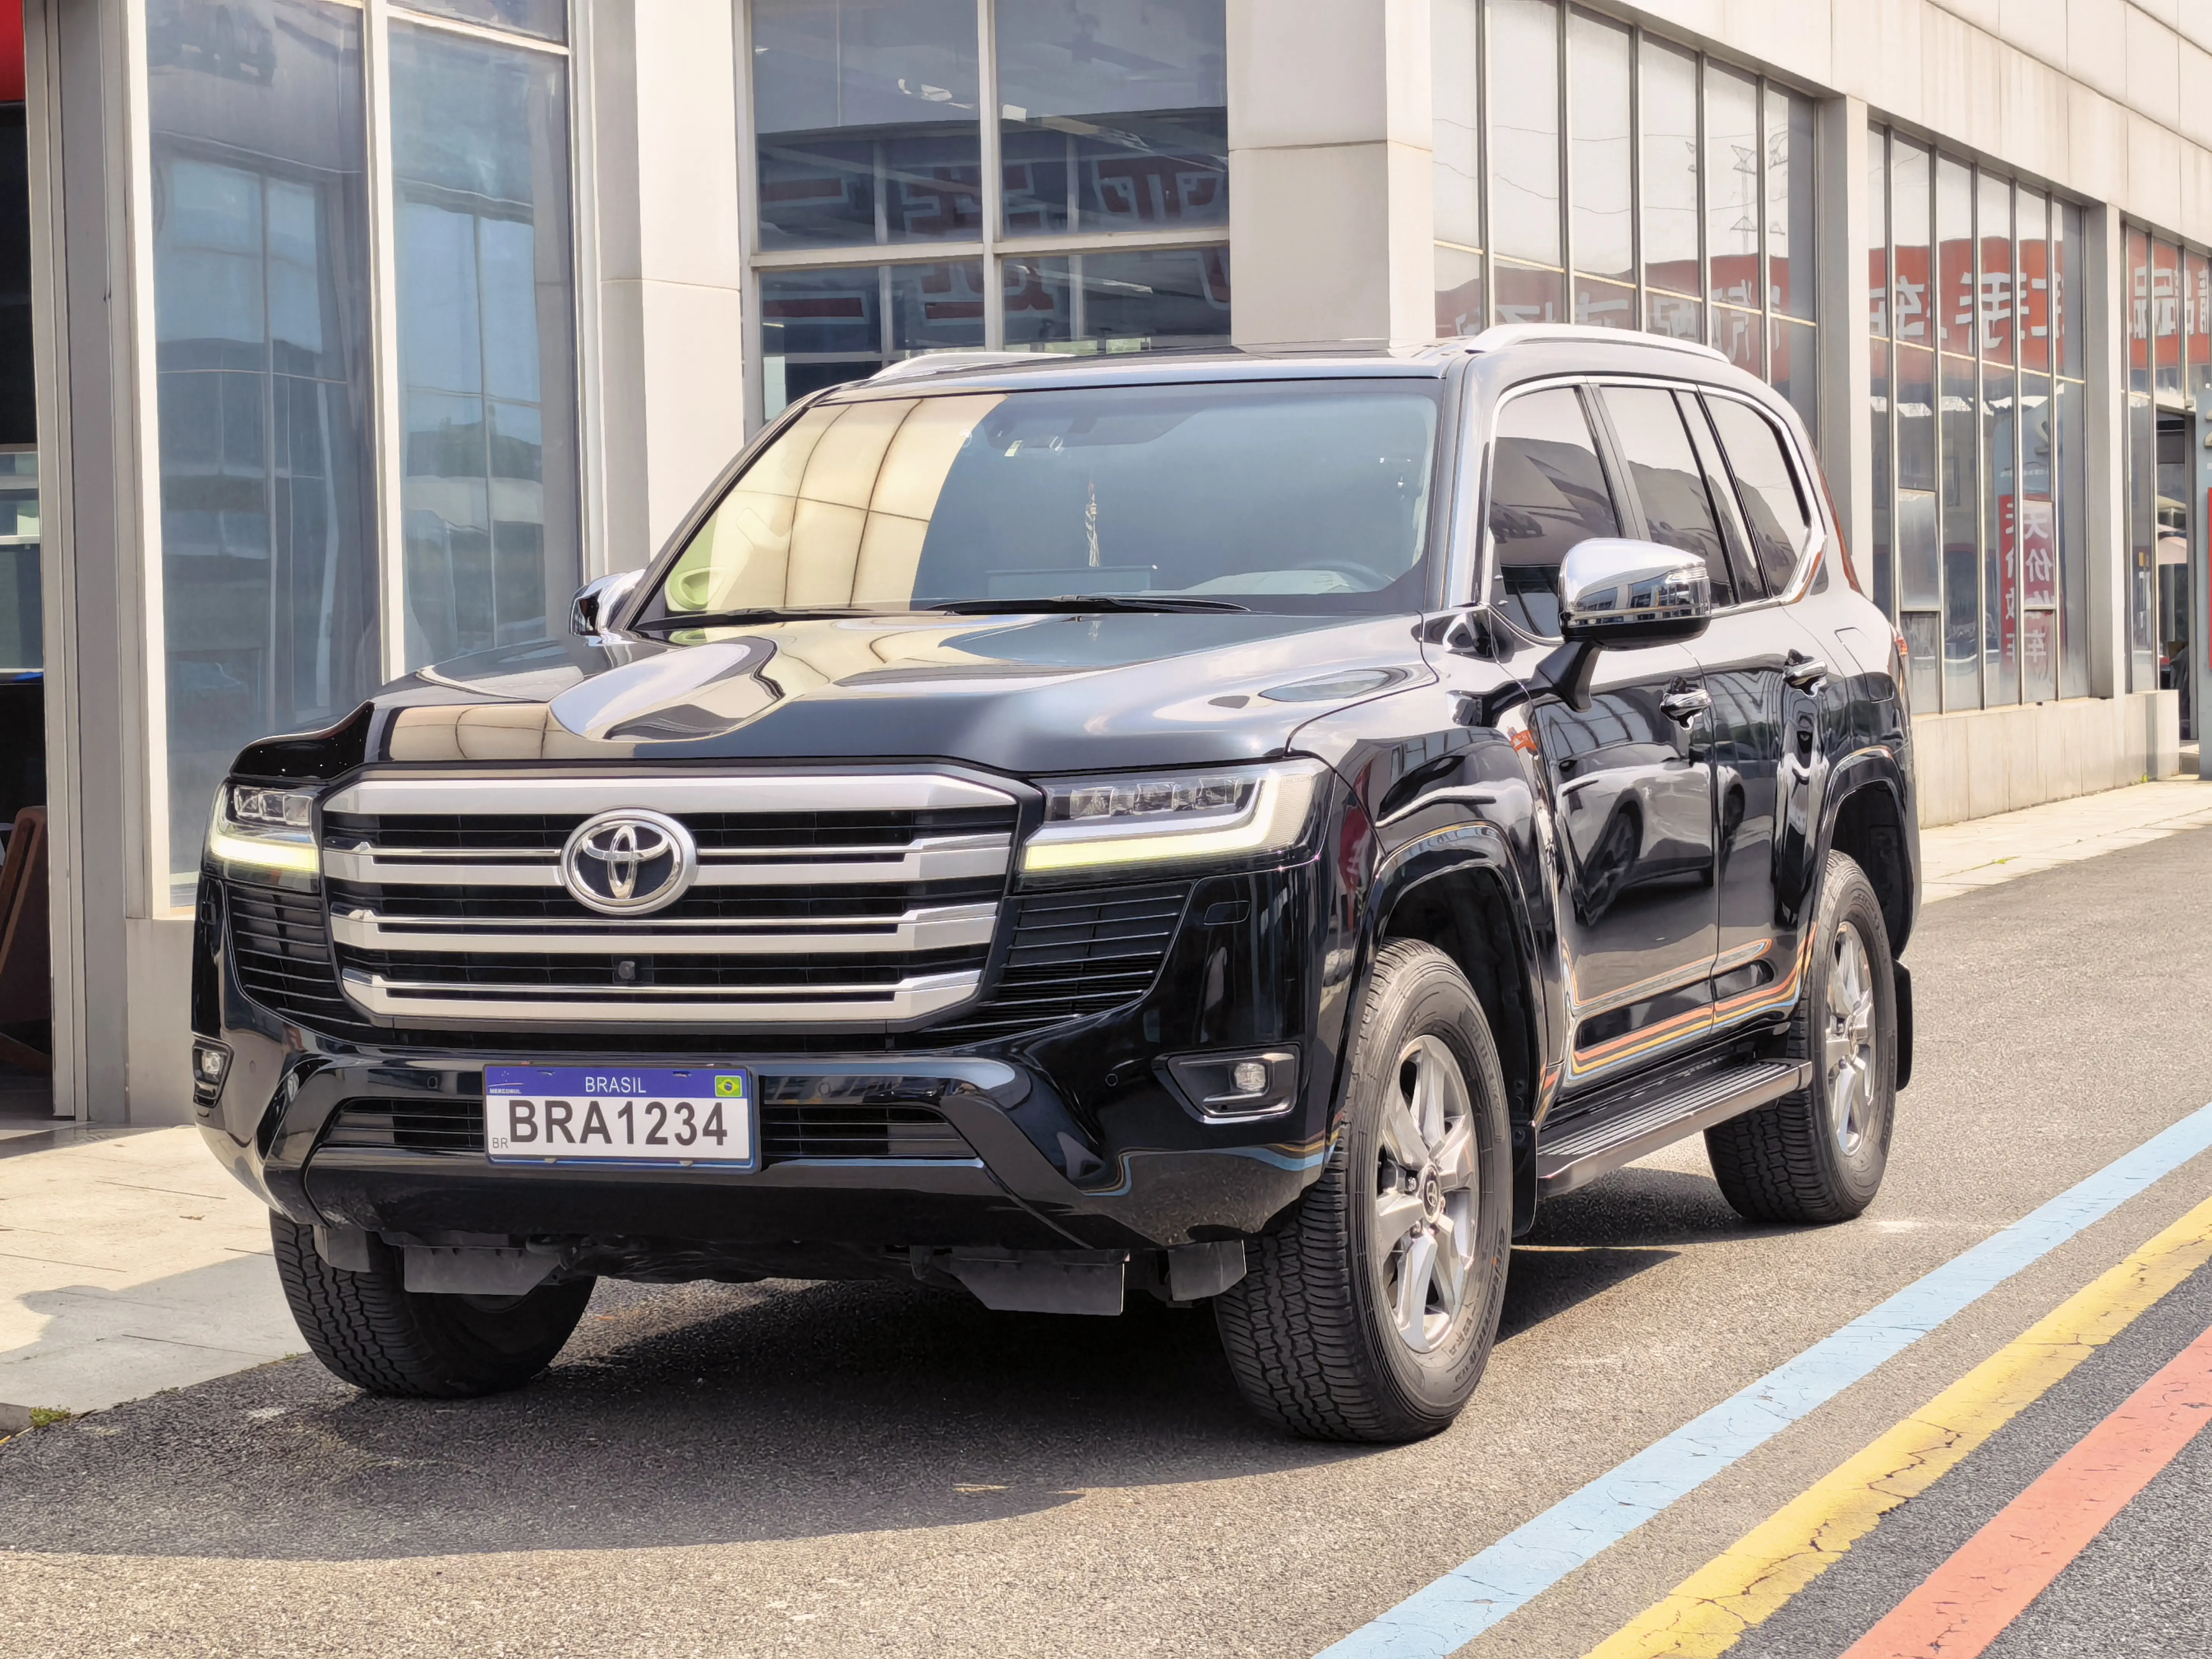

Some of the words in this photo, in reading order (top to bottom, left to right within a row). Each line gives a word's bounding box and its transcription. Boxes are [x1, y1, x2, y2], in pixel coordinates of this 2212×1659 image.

[585, 1076, 646, 1093] BRASIL
[508, 1099, 728, 1146] BRA1234
[492, 1137, 509, 1149] BR
